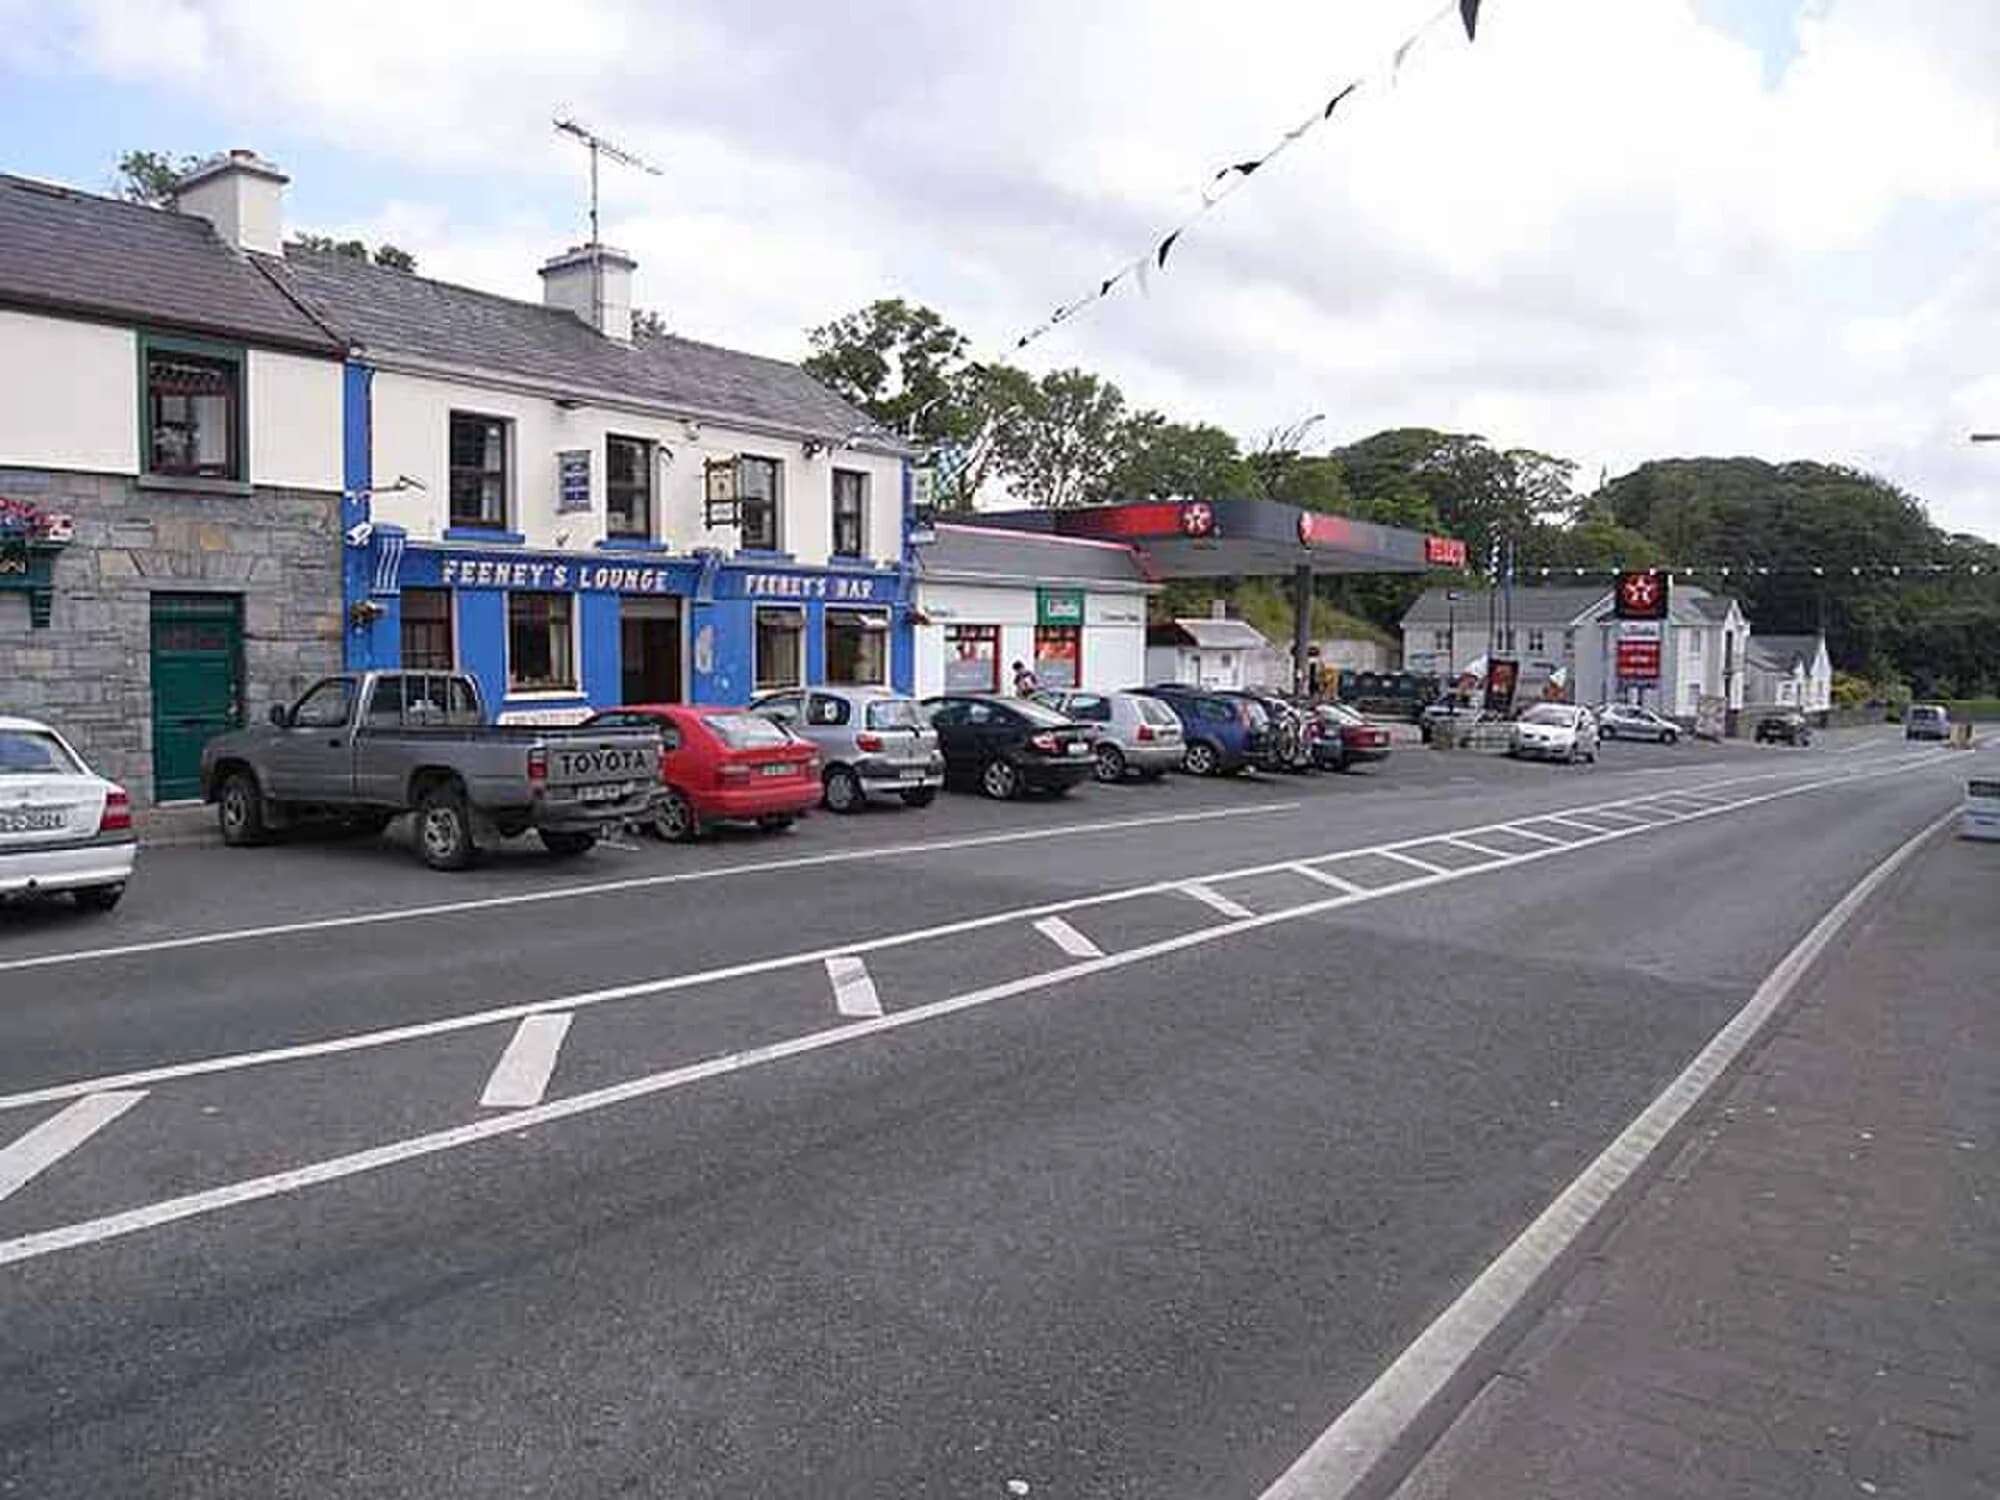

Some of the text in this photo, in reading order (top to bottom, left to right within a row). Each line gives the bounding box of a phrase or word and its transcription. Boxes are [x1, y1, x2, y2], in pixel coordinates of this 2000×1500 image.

[442, 560, 669, 592] FEENEY'S LOUNGE
[561, 751, 647, 776] TOYOTA
